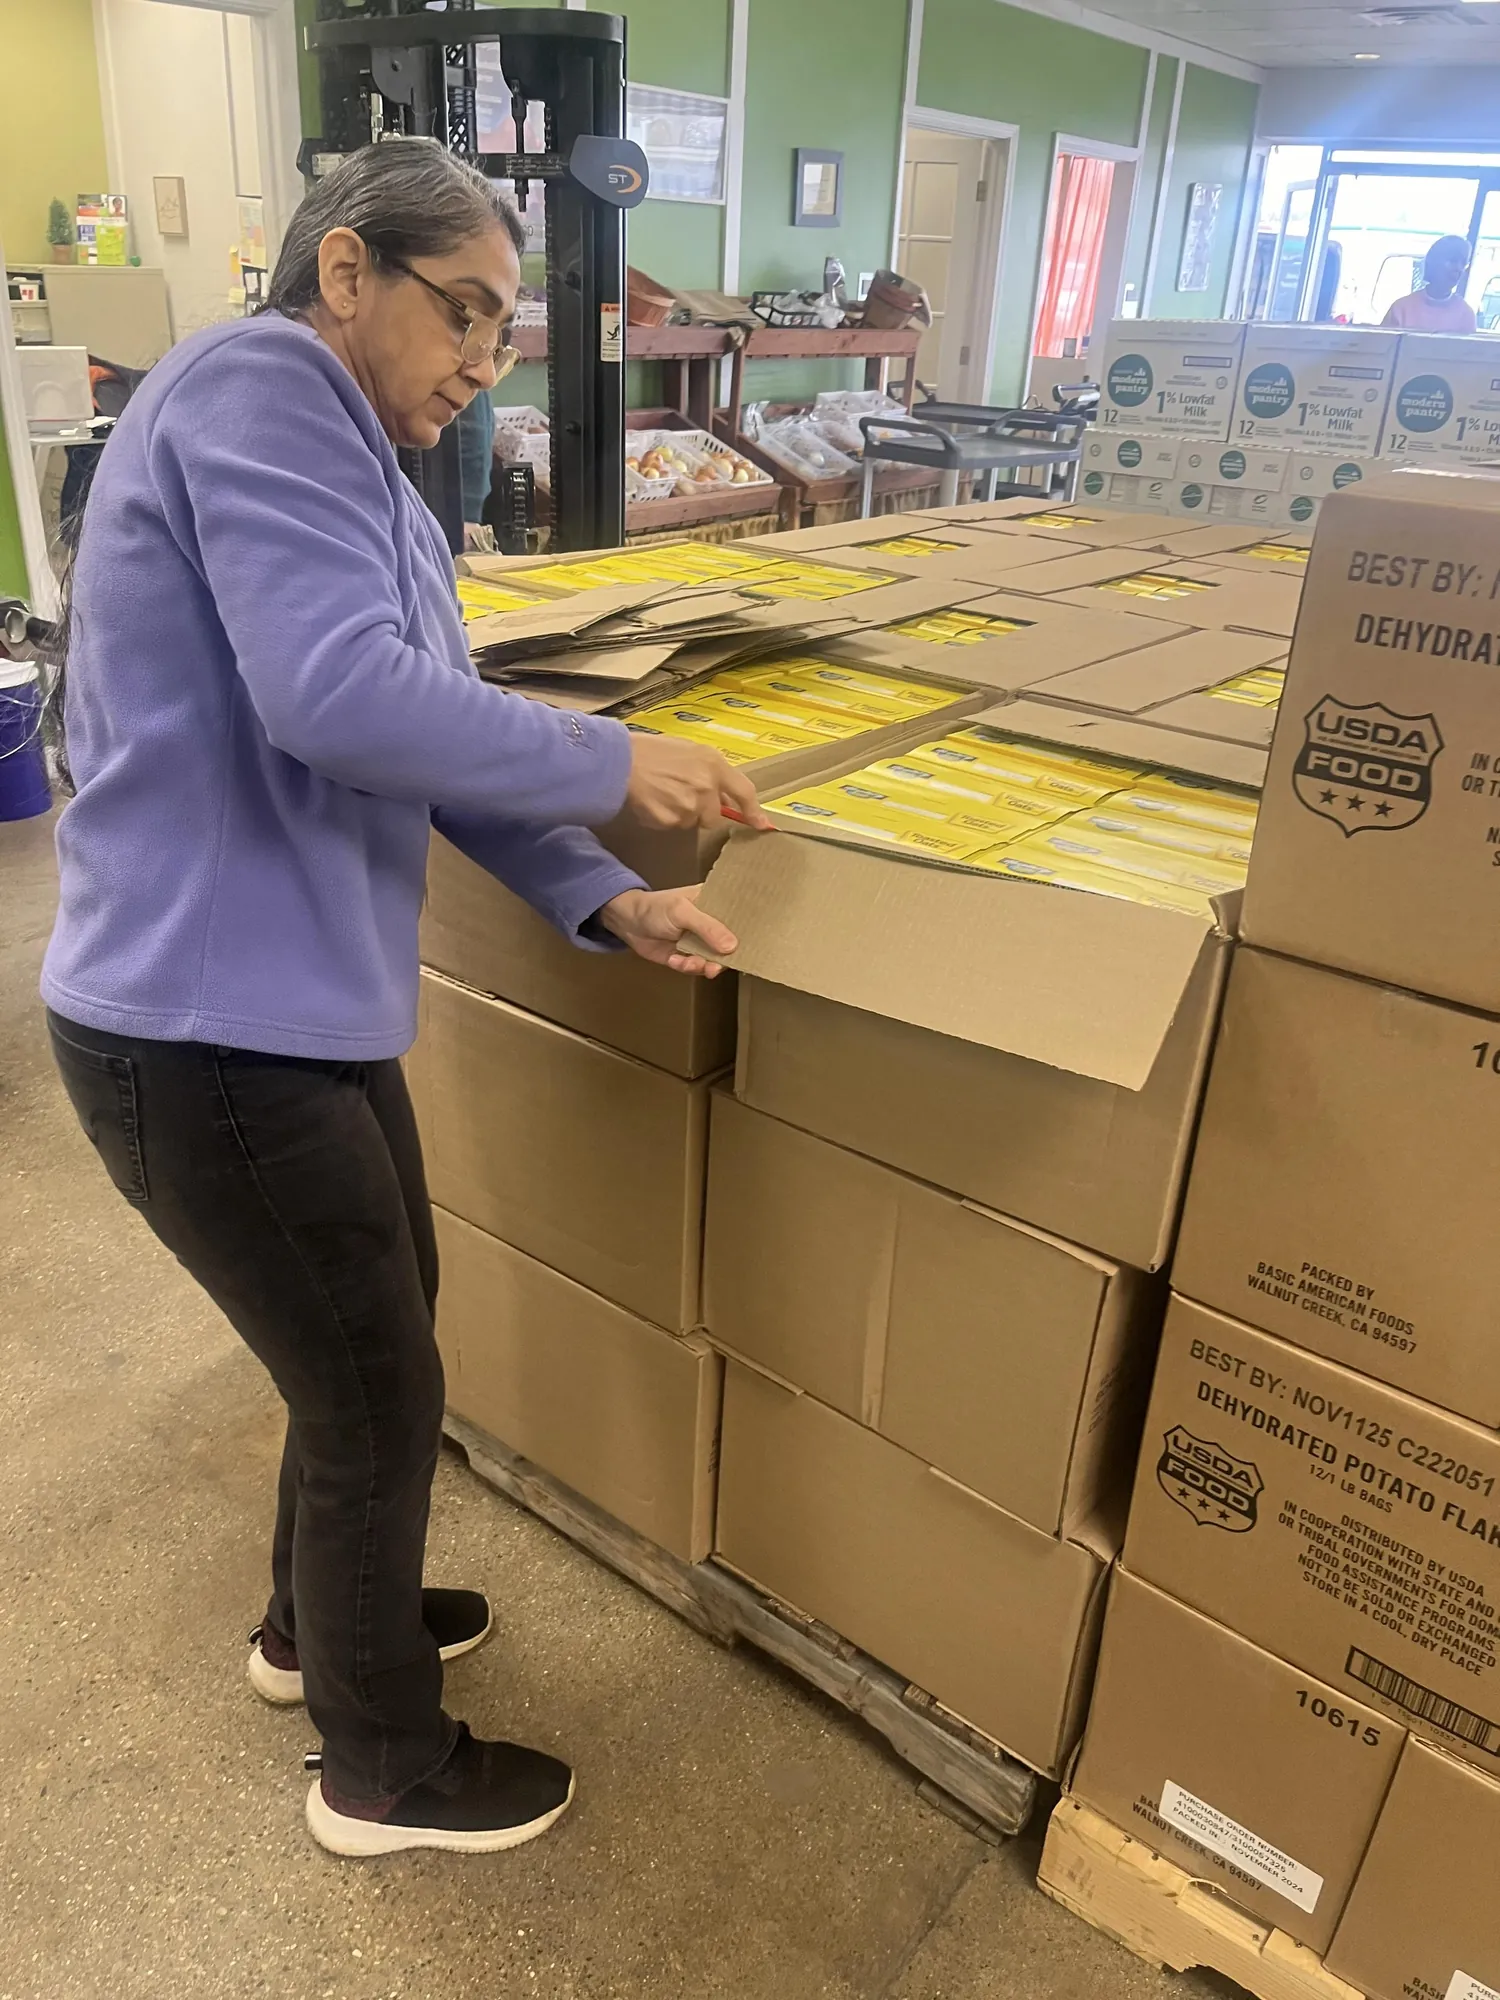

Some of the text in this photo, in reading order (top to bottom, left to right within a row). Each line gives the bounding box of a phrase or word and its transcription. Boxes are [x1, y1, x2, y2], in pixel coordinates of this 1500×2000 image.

[608, 174, 627, 184] ST
[1110, 374, 1148, 385] modern
[1115, 384, 1148, 395] pantry
[1248, 384, 1288, 395] modern
[1179, 392, 1215, 405] Lowfat
[1252, 394, 1290, 406] pantry
[1401, 398, 1446, 408] modern
[1104, 408, 1118, 423] 12
[1184, 406, 1207, 417] Milk
[1322, 404, 1364, 419] Lowfat
[1405, 407, 1446, 420] pantry
[1240, 420, 1254, 434] 12
[1328, 418, 1353, 431] Milk
[1484, 420, 1500, 432] Lo
[1391, 434, 1408, 450] 12
[1348, 551, 1429, 589] BEST
[1432, 562, 1484, 597] BY:
[1317, 712, 1428, 753] USDA
[1307, 750, 1420, 792] FOOD
[1471, 752, 1490, 770] IN
[1050, 782, 1074, 792] Oats
[1462, 774, 1484, 794] OR
[1008, 800, 1032, 812] Oats
[912, 832, 958, 848] Toasted
[914, 838, 940, 849] Oats
[1301, 1262, 1375, 1300] PACKED BY
[1257, 1262, 1415, 1336] BASIC AMERICAN FOODS
[1248, 1274, 1299, 1304] WALNUT
[1350, 1318, 1368, 1335] CA
[1372, 1328, 1417, 1354] 94597
[1190, 1338, 1495, 1497] BEST BY: NOV1125 C222051
[1198, 1380, 1338, 1464] DEHYDRATED
[1344, 1454, 1435, 1512] POTATO
[1173, 1434, 1254, 1488] USDA
[1167, 1458, 1249, 1512] FOOD
[1310, 1464, 1393, 1513] 12/1 LB BAGS
[1278, 1512, 1294, 1529] OR
[1298, 1522, 1339, 1554] TRIBAL
[1342, 1548, 1436, 1604] GOVERNMENTS
[1439, 1599, 1466, 1620] FOR
[1284, 1500, 1495, 1618] IN COOPERATION WITH STATE AND
[1340, 1515, 1484, 1598] DISTRIBUTED BY USDA
[1308, 1544, 1496, 1651] FOOD ASSISTANCE PROGRAMS
[1298, 1553, 1496, 1668] NOT TO BE SOLD OR EXCHANGED
[1303, 1571, 1342, 1600] STORE
[1344, 1594, 1358, 1608] IN
[1360, 1604, 1368, 1615] A
[1412, 1632, 1438, 1652] DRY
[1440, 1648, 1484, 1676] PLACE
[1296, 1690, 1380, 1746] 10615
[1140, 1794, 1160, 1812] BAS
[1179, 1791, 1224, 1823] PURCHASE
[1226, 1822, 1256, 1843] ORDER
[1132, 1802, 1171, 1834] WALNUT
[1212, 1855, 1226, 1870] CA
[1229, 1866, 1262, 1891] 94597
[1173, 1806, 1206, 1831] PACKED
[1231, 1844, 1279, 1878] NOVEMBER
[1281, 1876, 1304, 1893] 2024
